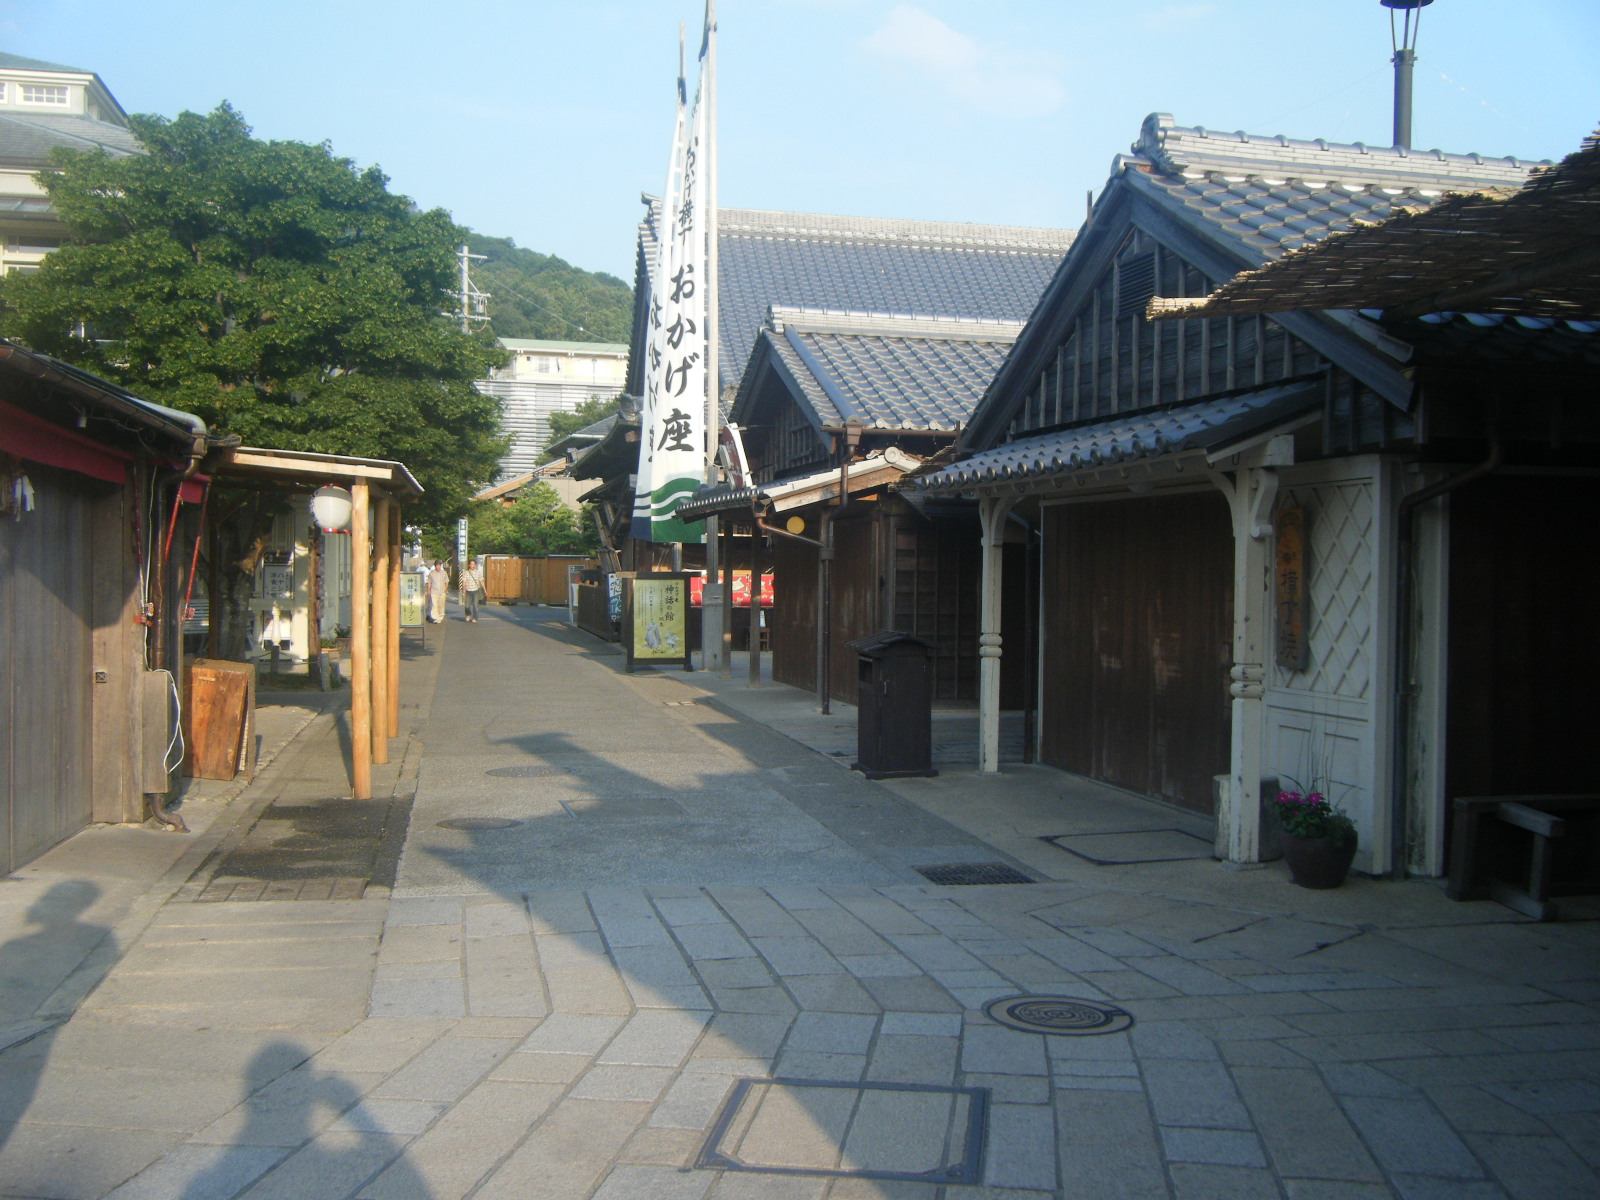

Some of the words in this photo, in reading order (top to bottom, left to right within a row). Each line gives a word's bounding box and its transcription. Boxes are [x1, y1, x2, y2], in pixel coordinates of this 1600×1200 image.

[657, 264, 700, 452] おかげ座
[665, 585, 674, 622] 神話の館
